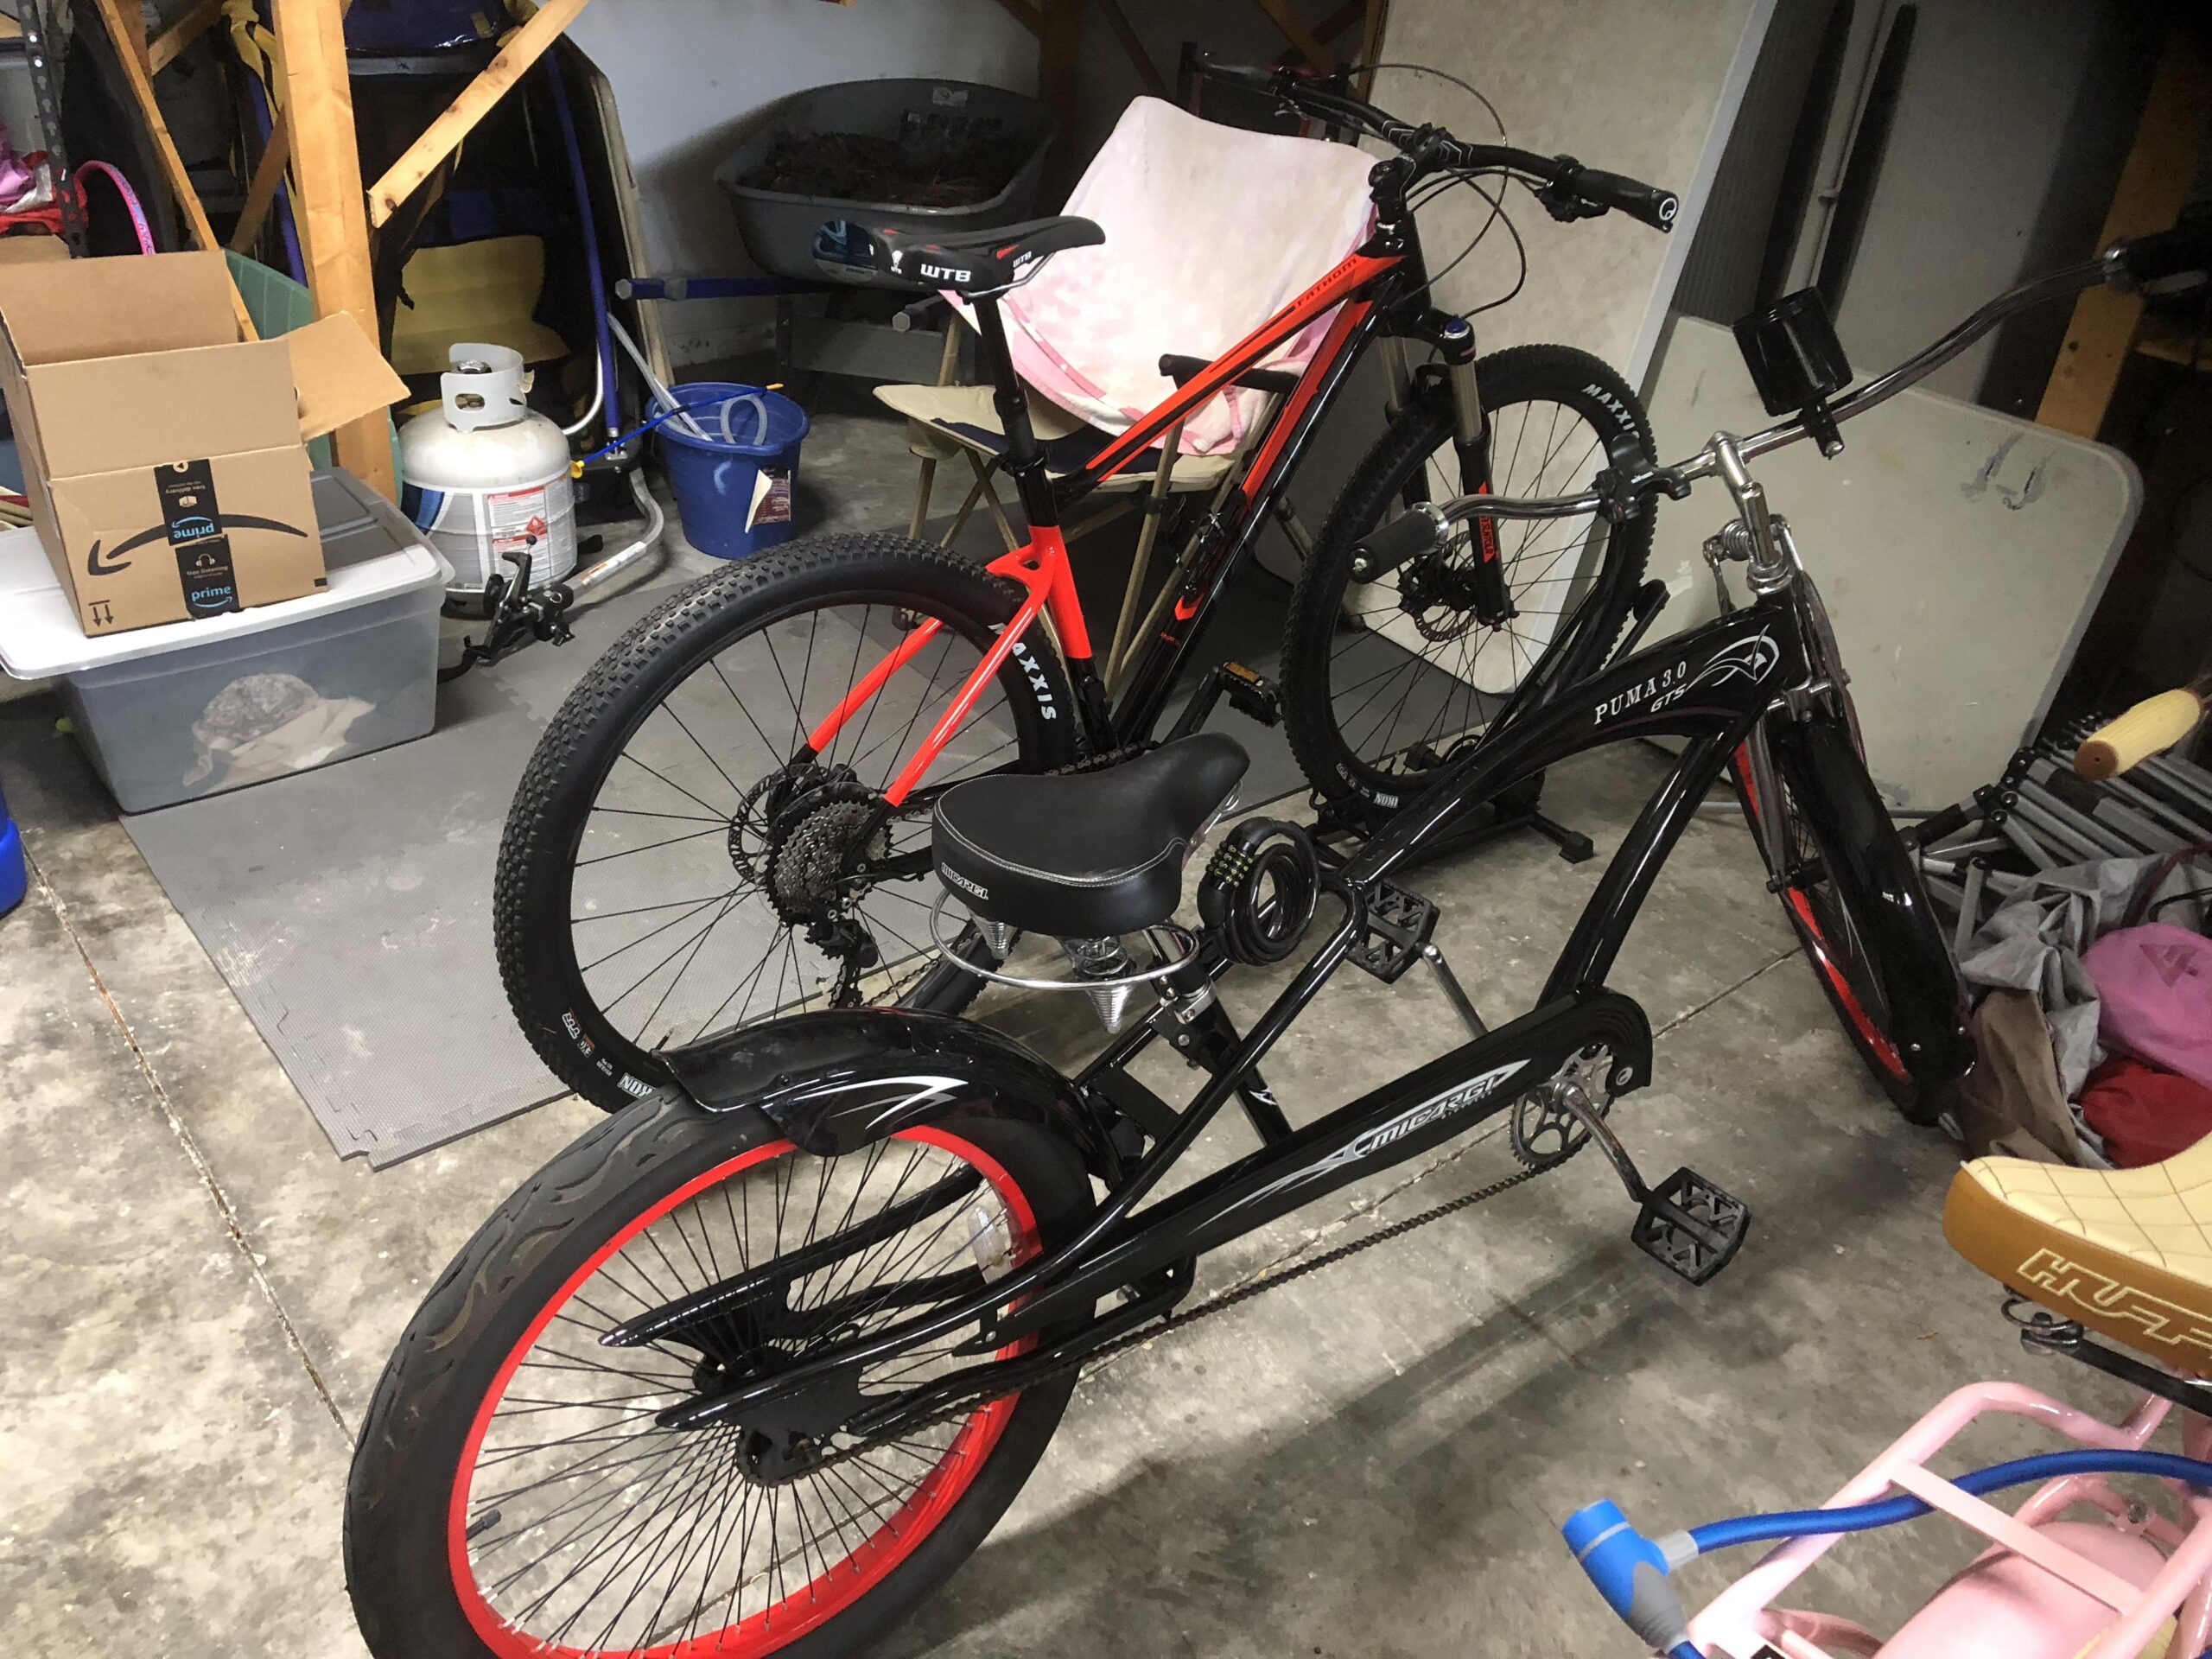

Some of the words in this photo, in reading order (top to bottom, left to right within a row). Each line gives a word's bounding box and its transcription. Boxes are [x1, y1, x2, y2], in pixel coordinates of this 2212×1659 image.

[1013, 251, 1032, 267] WTB
[921, 264, 971, 283] WTB
[1297, 258, 1357, 307] FATHOM
[173, 523, 214, 539] prime
[191, 587, 232, 602] prime
[1594, 677, 1657, 725] PUMA
[1662, 660, 1687, 688] 3.0
[1650, 683, 1687, 713] GTS
[619, 1074, 654, 1098] KON
